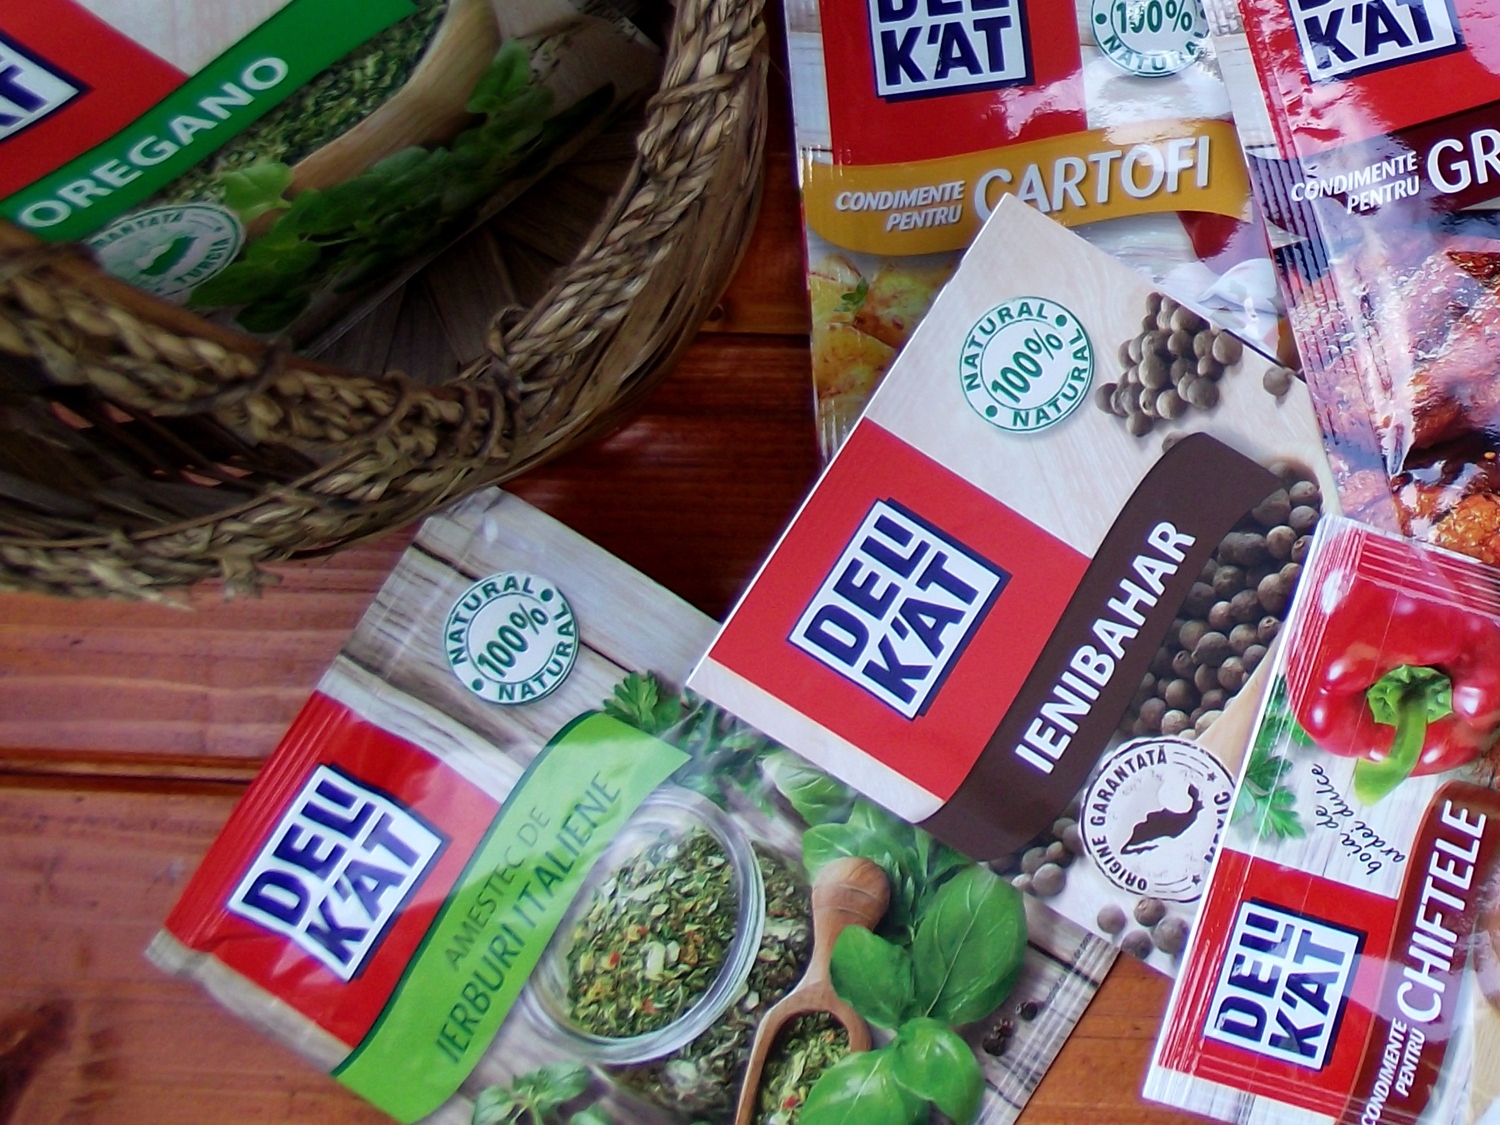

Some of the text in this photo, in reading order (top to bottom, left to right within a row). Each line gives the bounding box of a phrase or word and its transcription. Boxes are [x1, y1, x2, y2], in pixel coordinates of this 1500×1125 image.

[1116, 0, 1192, 33] 100%
[19, 57, 289, 227] OREGANO
[835, 135, 1211, 222] CONDIMENTE CARTOFI
[1291, 151, 1418, 201] CONDIMENTE
[886, 205, 962, 232] PENTRU
[1347, 175, 1419, 213] PENTRU
[964, 302, 1048, 392] NATURAL
[991, 328, 1064, 404] 100%
[1012, 328, 1089, 426] NATURAL
[449, 576, 534, 665] NATURAL
[803, 507, 929, 667] DELI
[478, 603, 549, 677] 100%
[499, 603, 574, 700] NATURAL
[1013, 520, 1196, 774] IENIBAHAR
[242, 778, 378, 928] DELI
[1090, 745, 1167, 891] ORIGINE GARANTATĂ
[1311, 764, 1406, 862] ardei dulce
[1316, 805, 1382, 875] boia de
[436, 772, 621, 1066] IERBURI ITALIENE
[446, 805, 550, 972] AMESTEC DE
[1218, 913, 1295, 1044] DELI
[1361, 800, 1487, 1125] CONDIMENTE CHIFTELE
[1395, 1027, 1425, 1096] PENTRU
